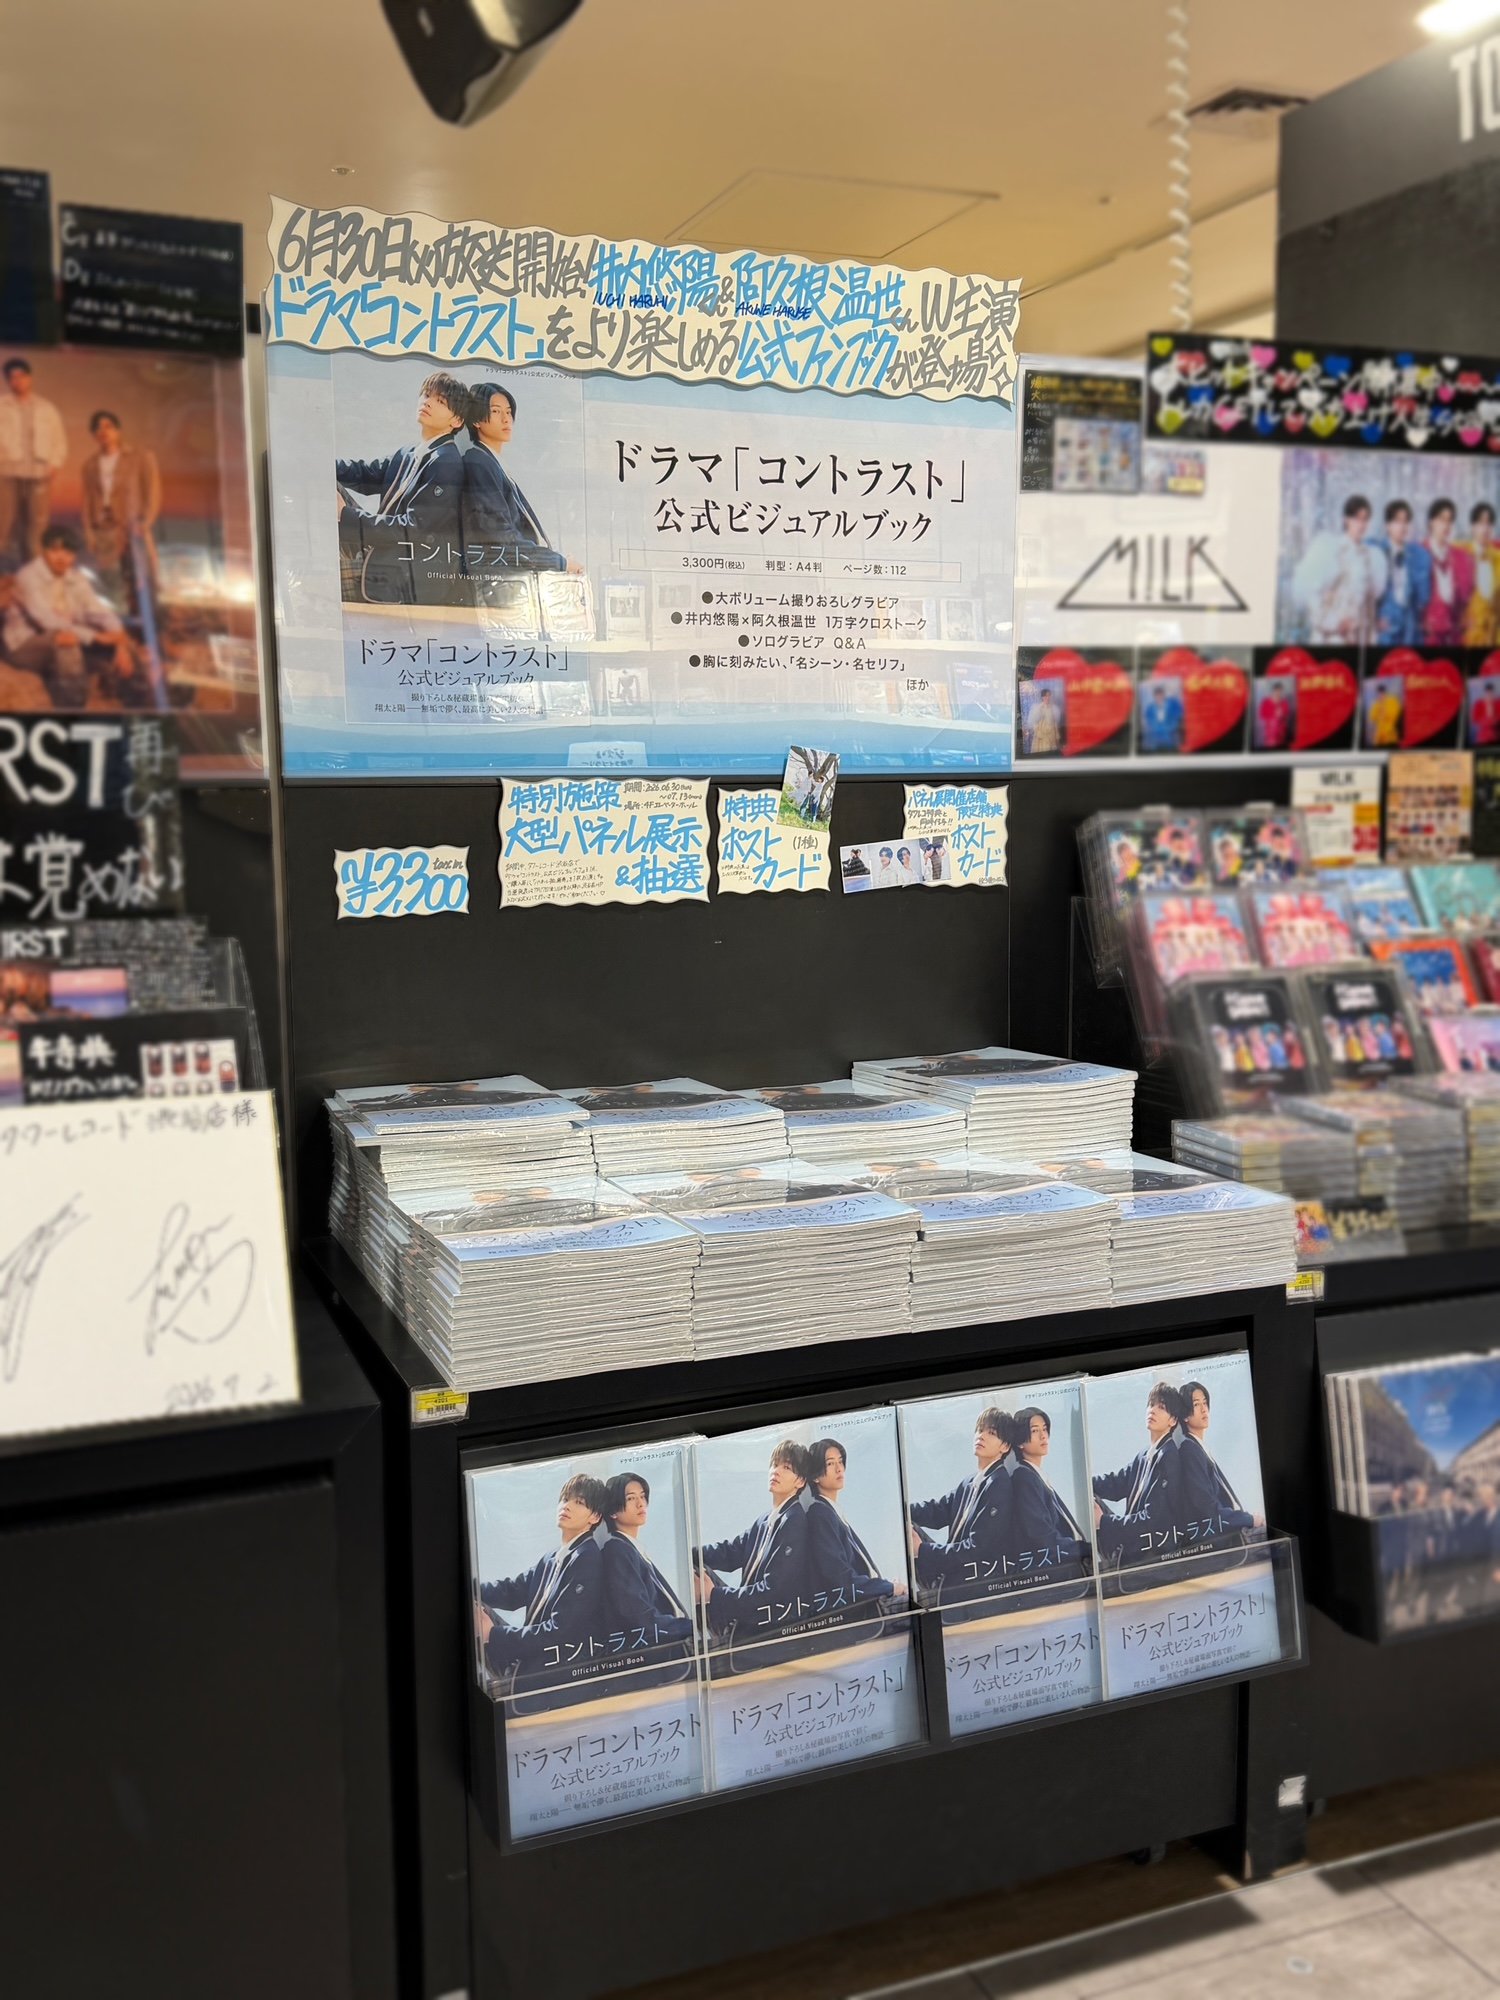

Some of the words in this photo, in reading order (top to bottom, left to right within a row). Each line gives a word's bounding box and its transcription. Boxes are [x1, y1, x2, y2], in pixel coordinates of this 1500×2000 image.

[615, 440, 965, 503] ドラマ「コントラスト」
[653, 498, 932, 542] 公式ビジュアルブック
[397, 541, 530, 566] コントラスト
[427, 572, 456, 580] Official
[458, 572, 484, 581] Visual
[825, 615, 927, 631] 1万字クロストーク
[360, 638, 568, 671] ドラマ「コントラスト」
[753, 635, 824, 649] ソログラビア
[834, 636, 866, 650] Q&A
[397, 669, 535, 687] 公式ビジュアルブック
[906, 678, 929, 692] ほか
[508, 781, 622, 815] 特別施策
[722, 793, 777, 823] 特典
[504, 814, 703, 858] 大型パネル展示
[722, 826, 782, 863] ポスト
[793, 835, 818, 850] (1種)
[951, 822, 996, 850] ポスト
[615, 854, 705, 895] &抽選
[752, 853, 822, 889] カード
[958, 848, 1001, 878] カード
[340, 851, 467, 914] ¥3,300
[433, 857, 451, 871] tax
[453, 859, 464, 870] in
[1139, 1514, 1230, 1551] コントラスト
[964, 1545, 1069, 1581] コントラスト
[988, 1581, 1012, 1591] Official
[1013, 1577, 1033, 1587] Visual
[1034, 1574, 1049, 1583] Book
[757, 1583, 865, 1626] コントラスト
[1121, 1592, 1265, 1650] ドラマ「コントラスト」
[782, 1624, 806, 1636] Official
[807, 1619, 828, 1631] Visual
[829, 1614, 844, 1625] Book
[1150, 1622, 1243, 1661] 公式ビジュアルブック
[543, 1623, 669, 1667] コントラスト
[572, 1664, 599, 1677] Official
[601, 1659, 625, 1671] Visual
[626, 1655, 645, 1665] Book
[973, 1657, 1082, 1694] 公式ビジュアルブック
[732, 1667, 903, 1735] ドラマ「コントラスト」
[765, 1701, 876, 1746] 公式ビジュアルブック
[514, 1713, 701, 1778] ドラマ「コントラスト
[552, 1745, 681, 1791] 公式ビジュアルブック
